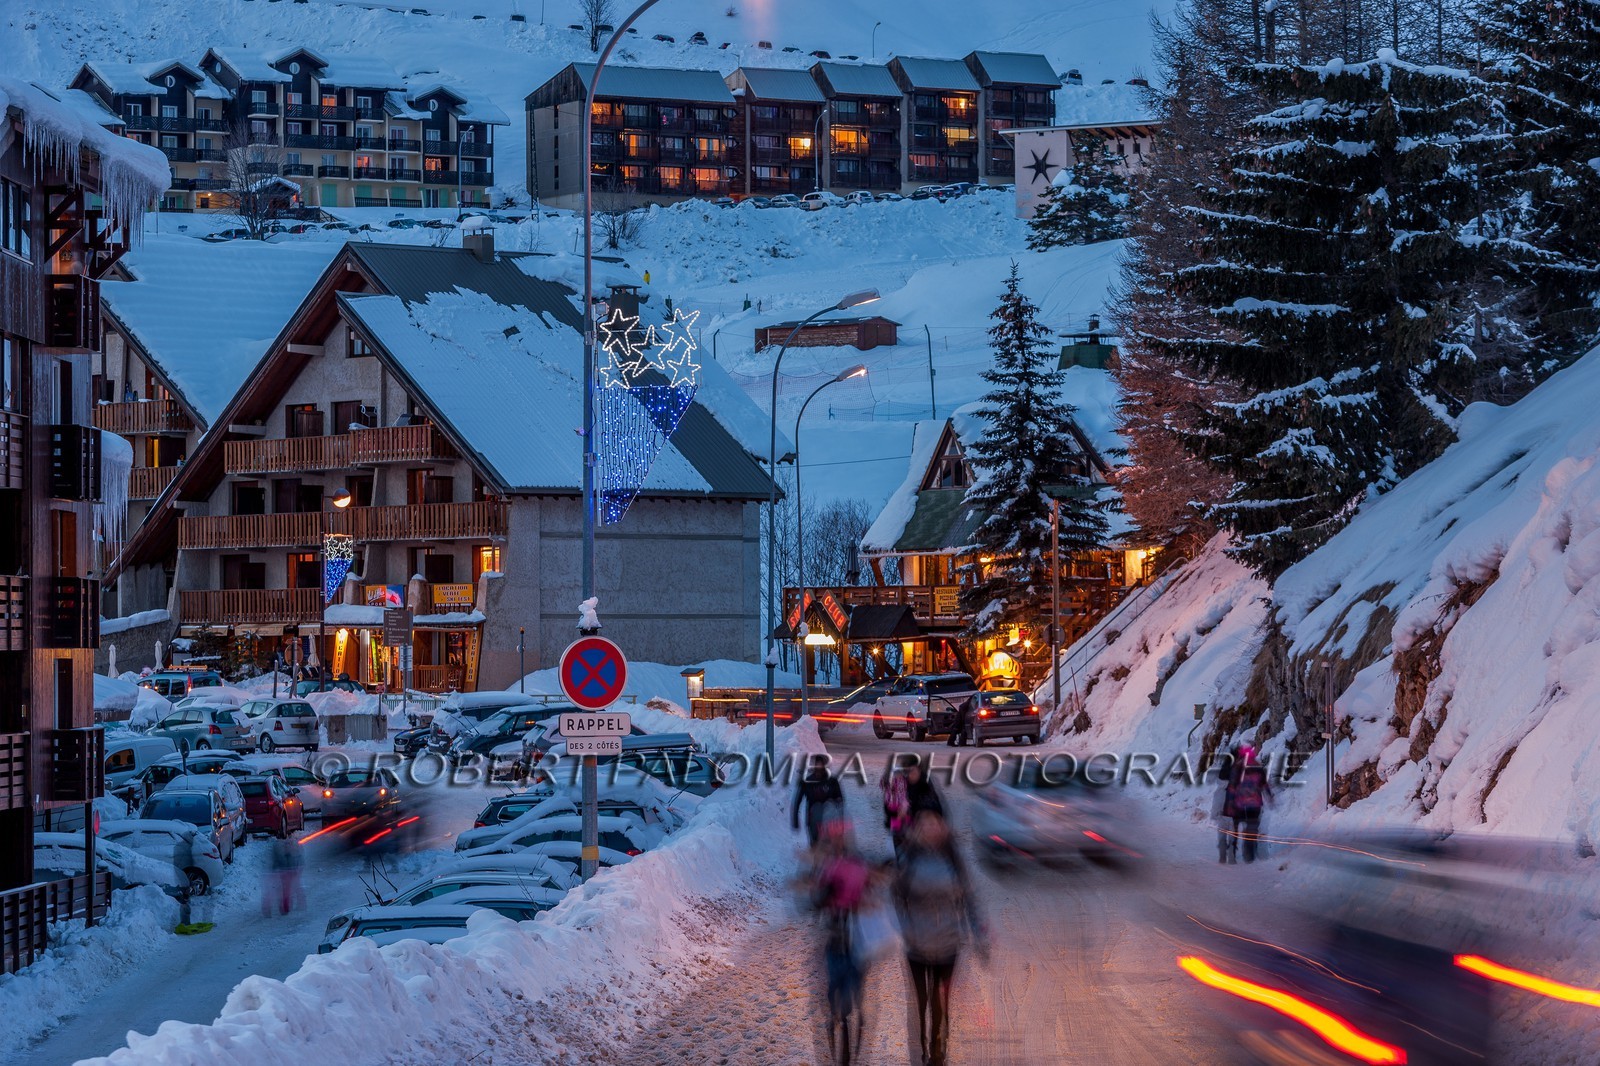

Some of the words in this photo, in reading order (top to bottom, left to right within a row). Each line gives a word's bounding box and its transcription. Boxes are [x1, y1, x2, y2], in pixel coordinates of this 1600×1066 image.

[824, 595, 845, 628] CLUB
[567, 719, 624, 731] RAPPEL
[569, 742, 584, 750] DES
[588, 742, 593, 750] 2
[596, 740, 620, 750] CÔTÉS
